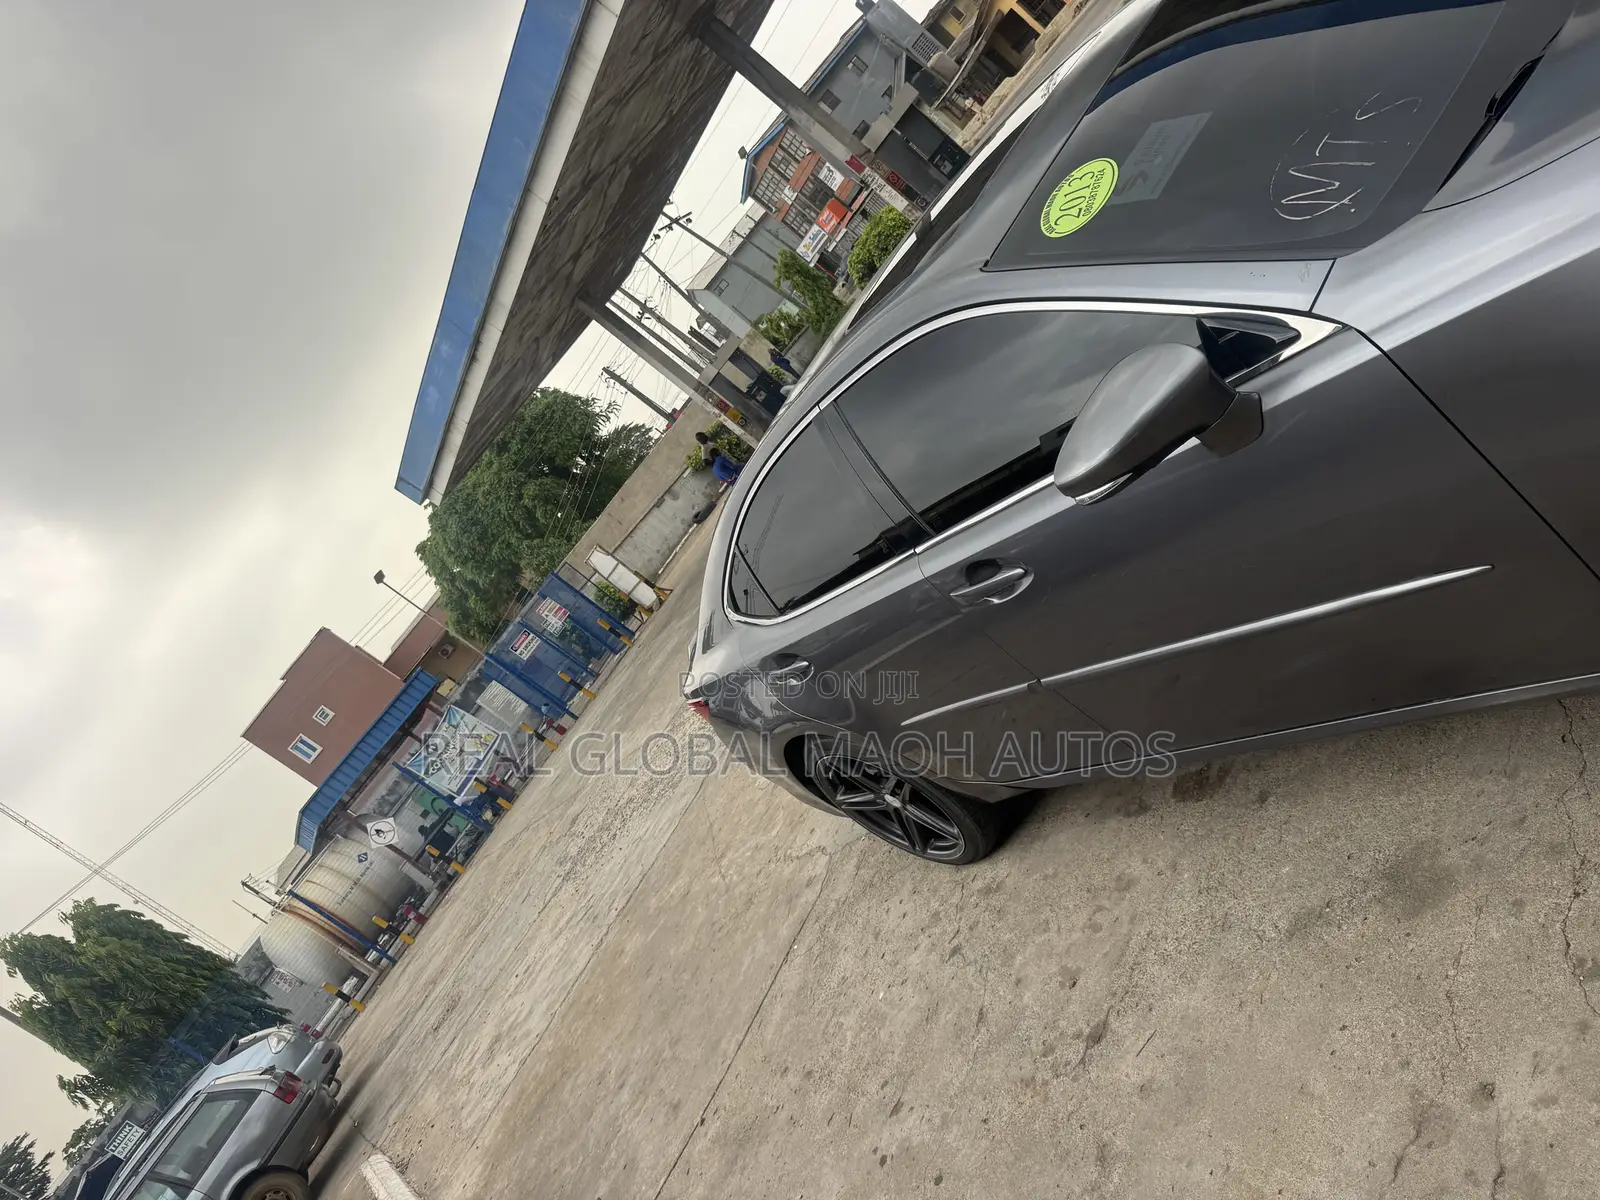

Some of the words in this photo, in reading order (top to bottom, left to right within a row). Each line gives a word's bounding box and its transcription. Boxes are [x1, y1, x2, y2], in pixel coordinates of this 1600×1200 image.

[1054, 171, 1095, 225] 2013
[108, 1124, 132, 1149] THINK
[117, 1128, 139, 1155] SAFETY
